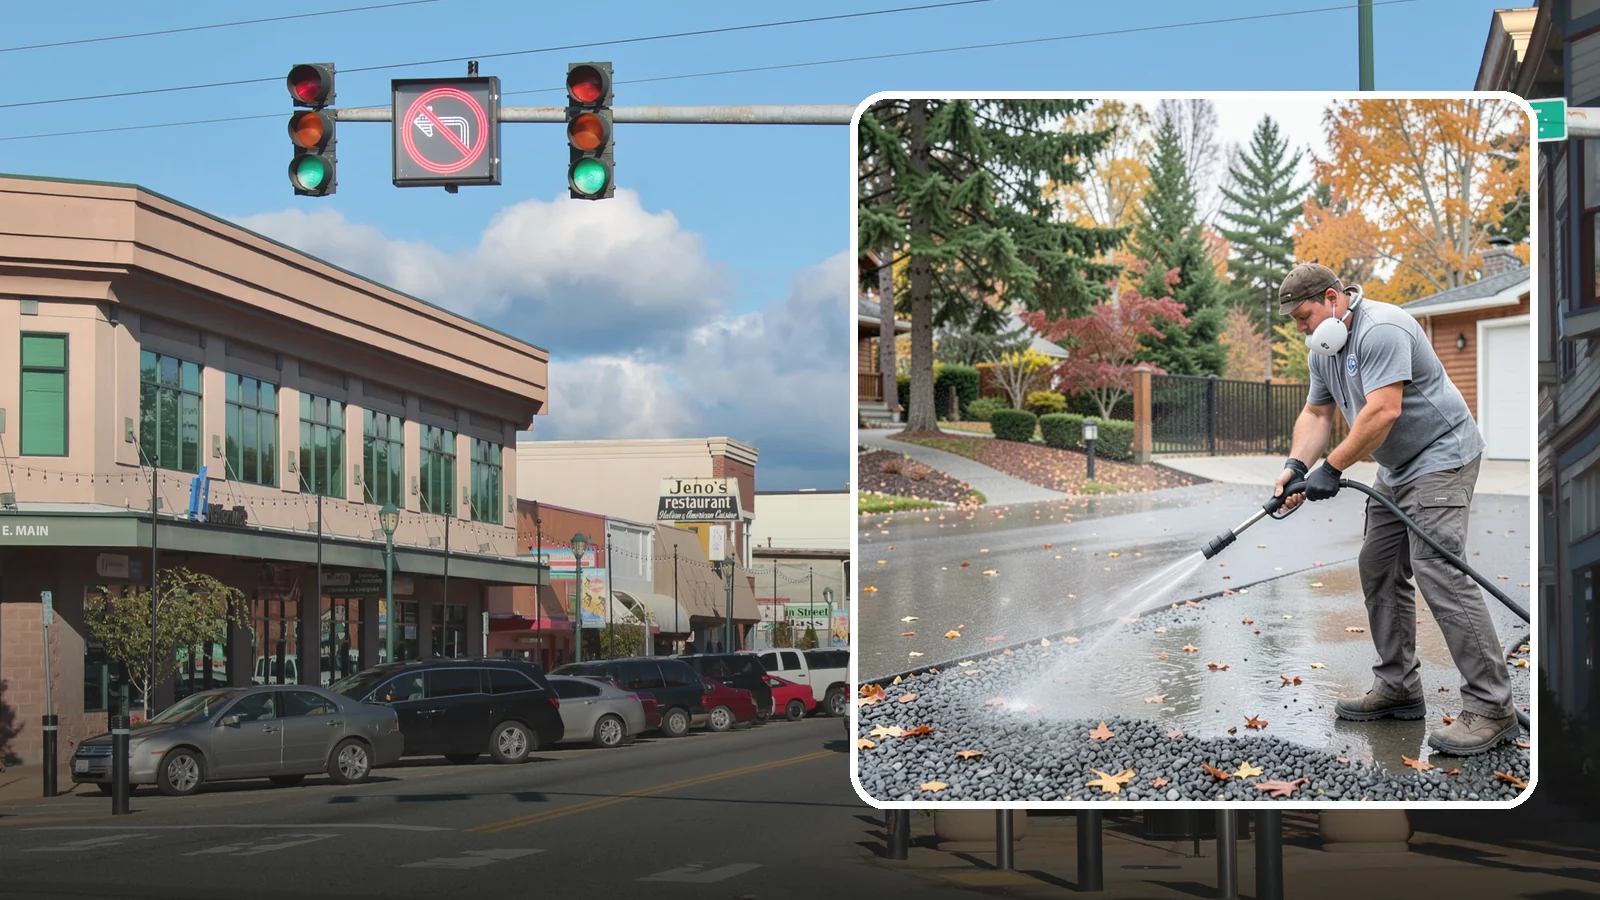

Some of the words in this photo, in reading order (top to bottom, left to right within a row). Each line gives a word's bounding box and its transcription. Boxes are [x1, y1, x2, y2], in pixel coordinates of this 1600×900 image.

[670, 480, 728, 494] Jeno's
[665, 496, 731, 509] restaurant
[658, 510, 681, 520] Italian
[686, 510, 715, 519] American
[715, 510, 738, 519] Cuisine
[2, 525, 13, 536] E.
[15, 525, 49, 536] MAIN
[785, 607, 795, 616] in
[797, 607, 829, 617] Street
[791, 619, 824, 627] lass
